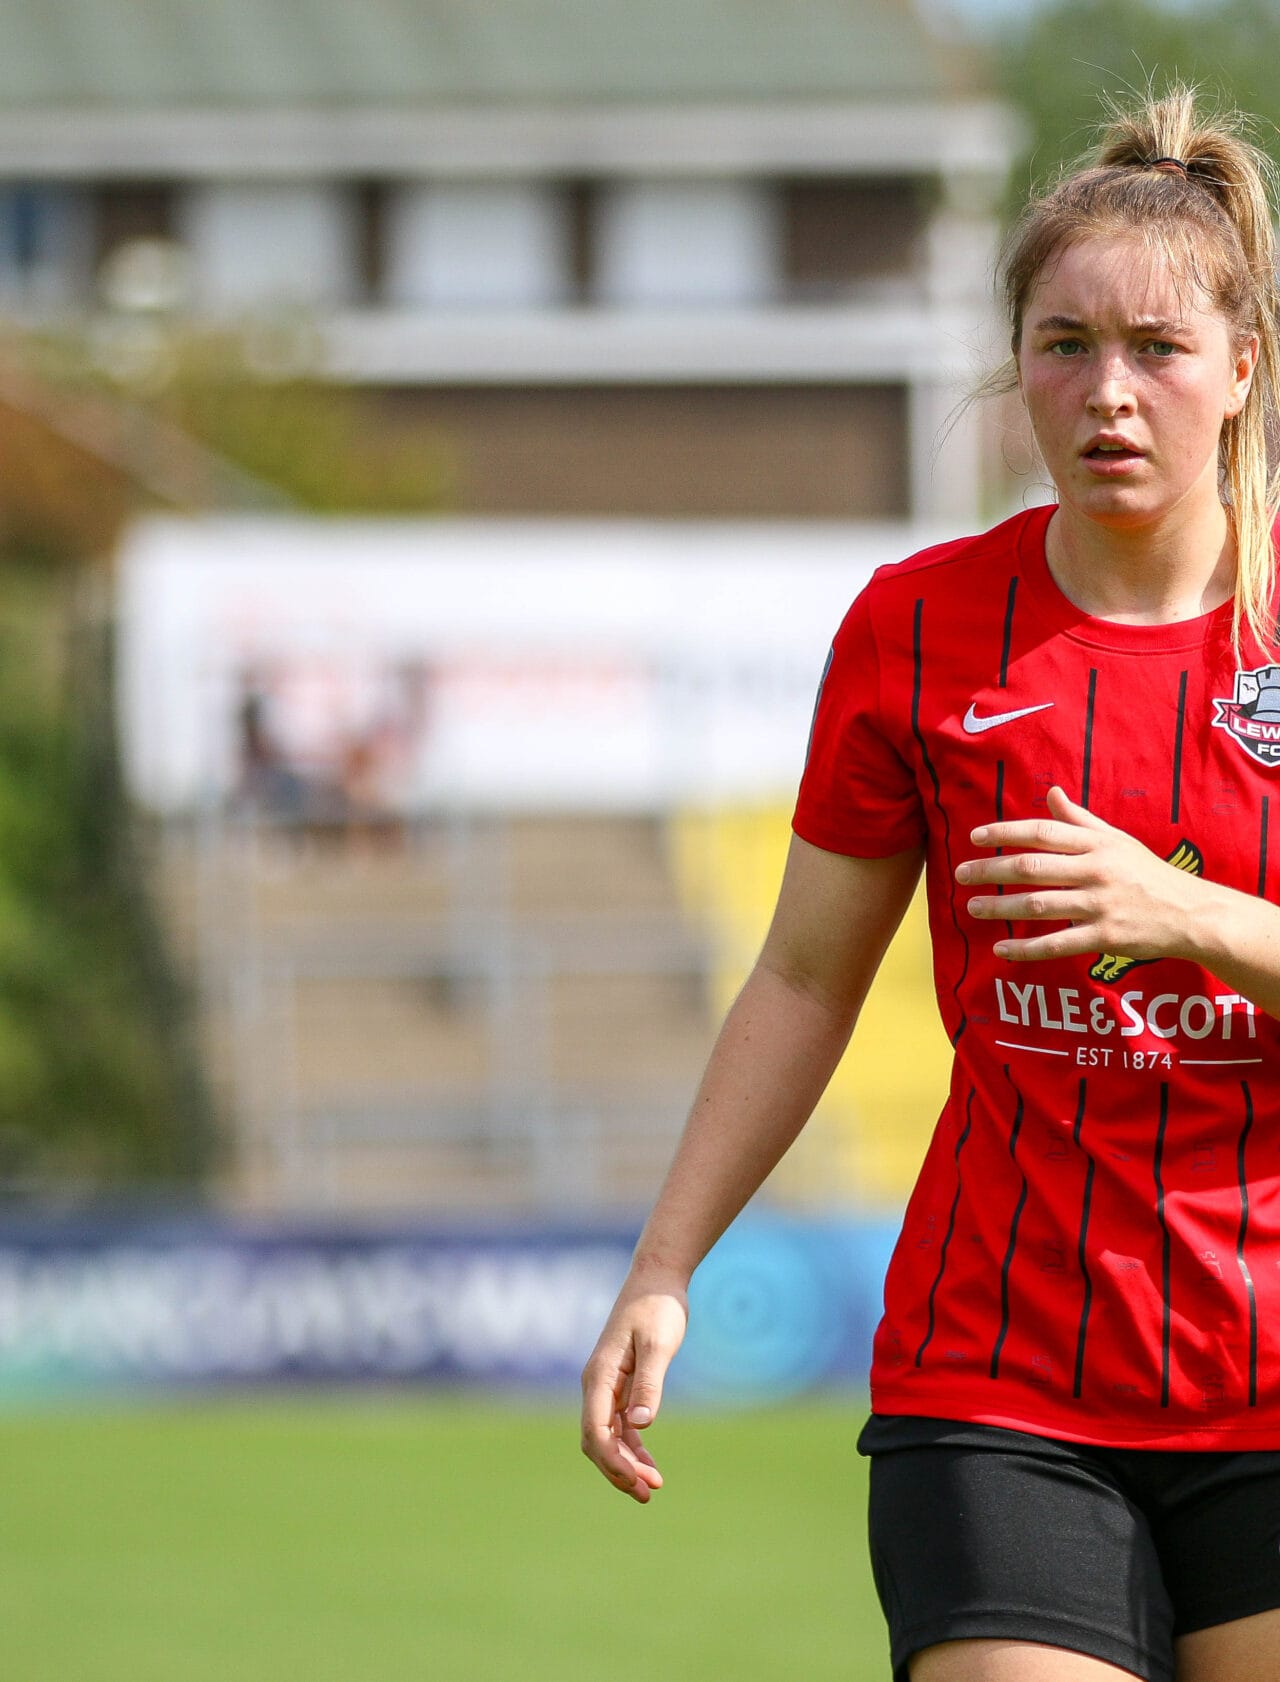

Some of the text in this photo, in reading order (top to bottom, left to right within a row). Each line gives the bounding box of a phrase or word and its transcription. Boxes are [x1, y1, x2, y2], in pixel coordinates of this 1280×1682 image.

[995, 978, 1256, 1040] LYLE & SCOTT
[1076, 1047, 1172, 1070] EST 1874
